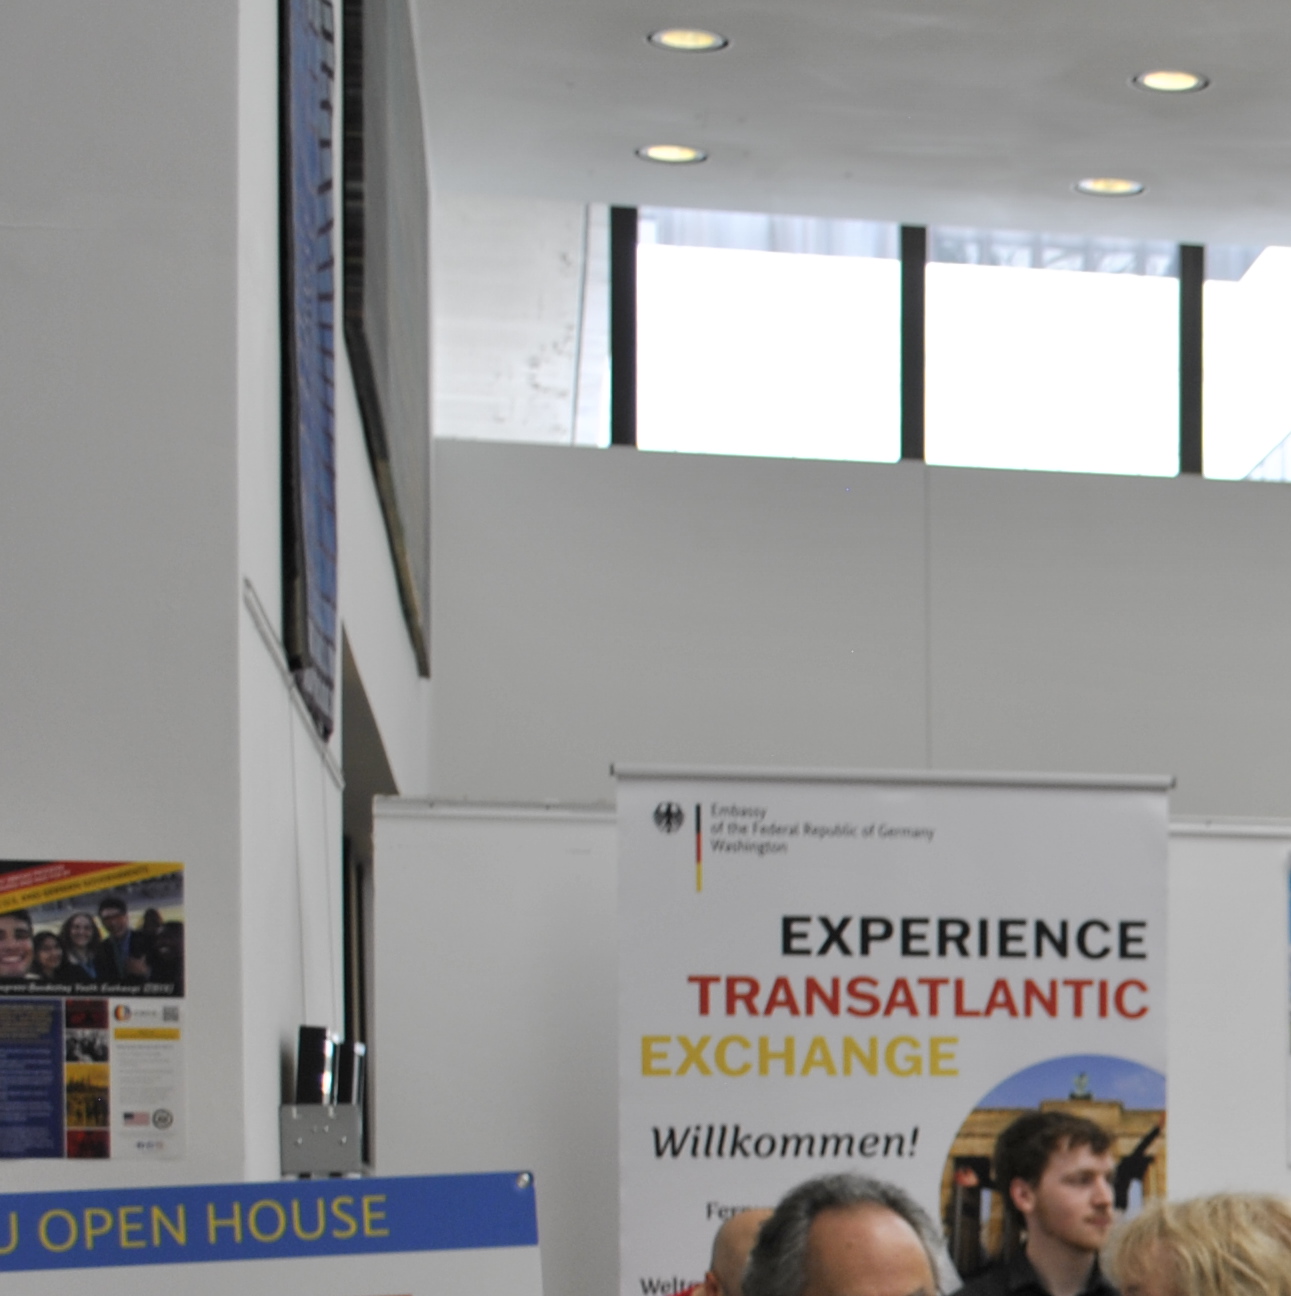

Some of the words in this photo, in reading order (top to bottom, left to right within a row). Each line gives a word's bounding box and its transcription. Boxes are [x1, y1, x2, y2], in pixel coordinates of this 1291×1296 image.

[711, 804, 767, 819] Embassy
[711, 822, 724, 835] of
[727, 822, 747, 835] the
[753, 822, 799, 836] Federal
[803, 823, 856, 841] Republic
[862, 823, 876, 838] of
[878, 824, 936, 843] Germany
[711, 840, 788, 857] Washington
[780, 915, 1149, 960] EXPERIENCE
[687, 975, 1151, 1020] TRANSATLANTIC
[640, 1034, 960, 1078] EXCHANGE
[652, 1125, 921, 1159] Willkommen!
[38, 1205, 188, 1252] OPEN
[206, 1194, 390, 1244] HOUSE
